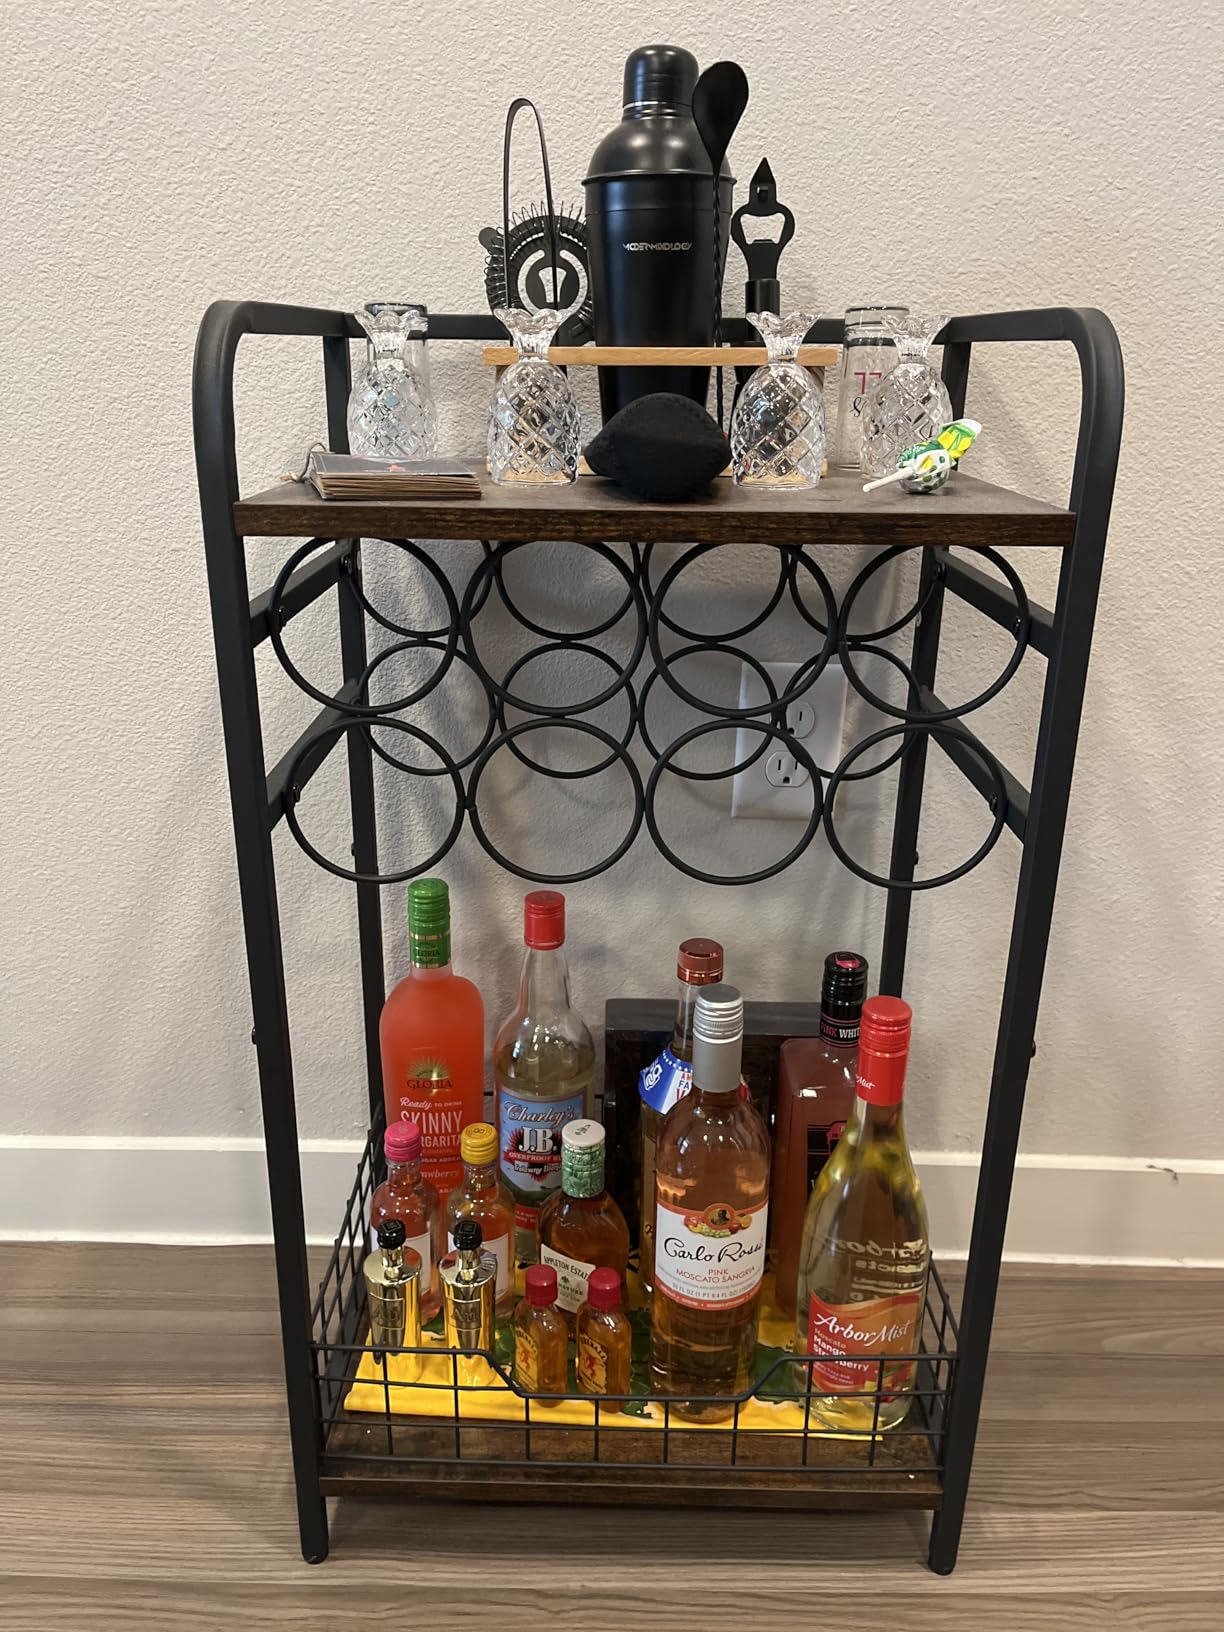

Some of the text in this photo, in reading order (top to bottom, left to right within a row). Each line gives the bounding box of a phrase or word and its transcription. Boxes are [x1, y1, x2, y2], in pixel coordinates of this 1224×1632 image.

[407, 1079, 452, 1089] GLORIA
[400, 1096, 432, 1111] Ready
[504, 1100, 576, 1128] Charley's
[401, 1110, 463, 1135] SKINNY
[518, 1126, 557, 1153] J.B.
[664, 1237, 764, 1263] Carlo Rossi
[676, 1268, 720, 1284] MOSCATO
[722, 1266, 755, 1283] SANGRIA
[708, 1268, 728, 1276] PINK
[814, 1313, 913, 1347] Arbor Mist
